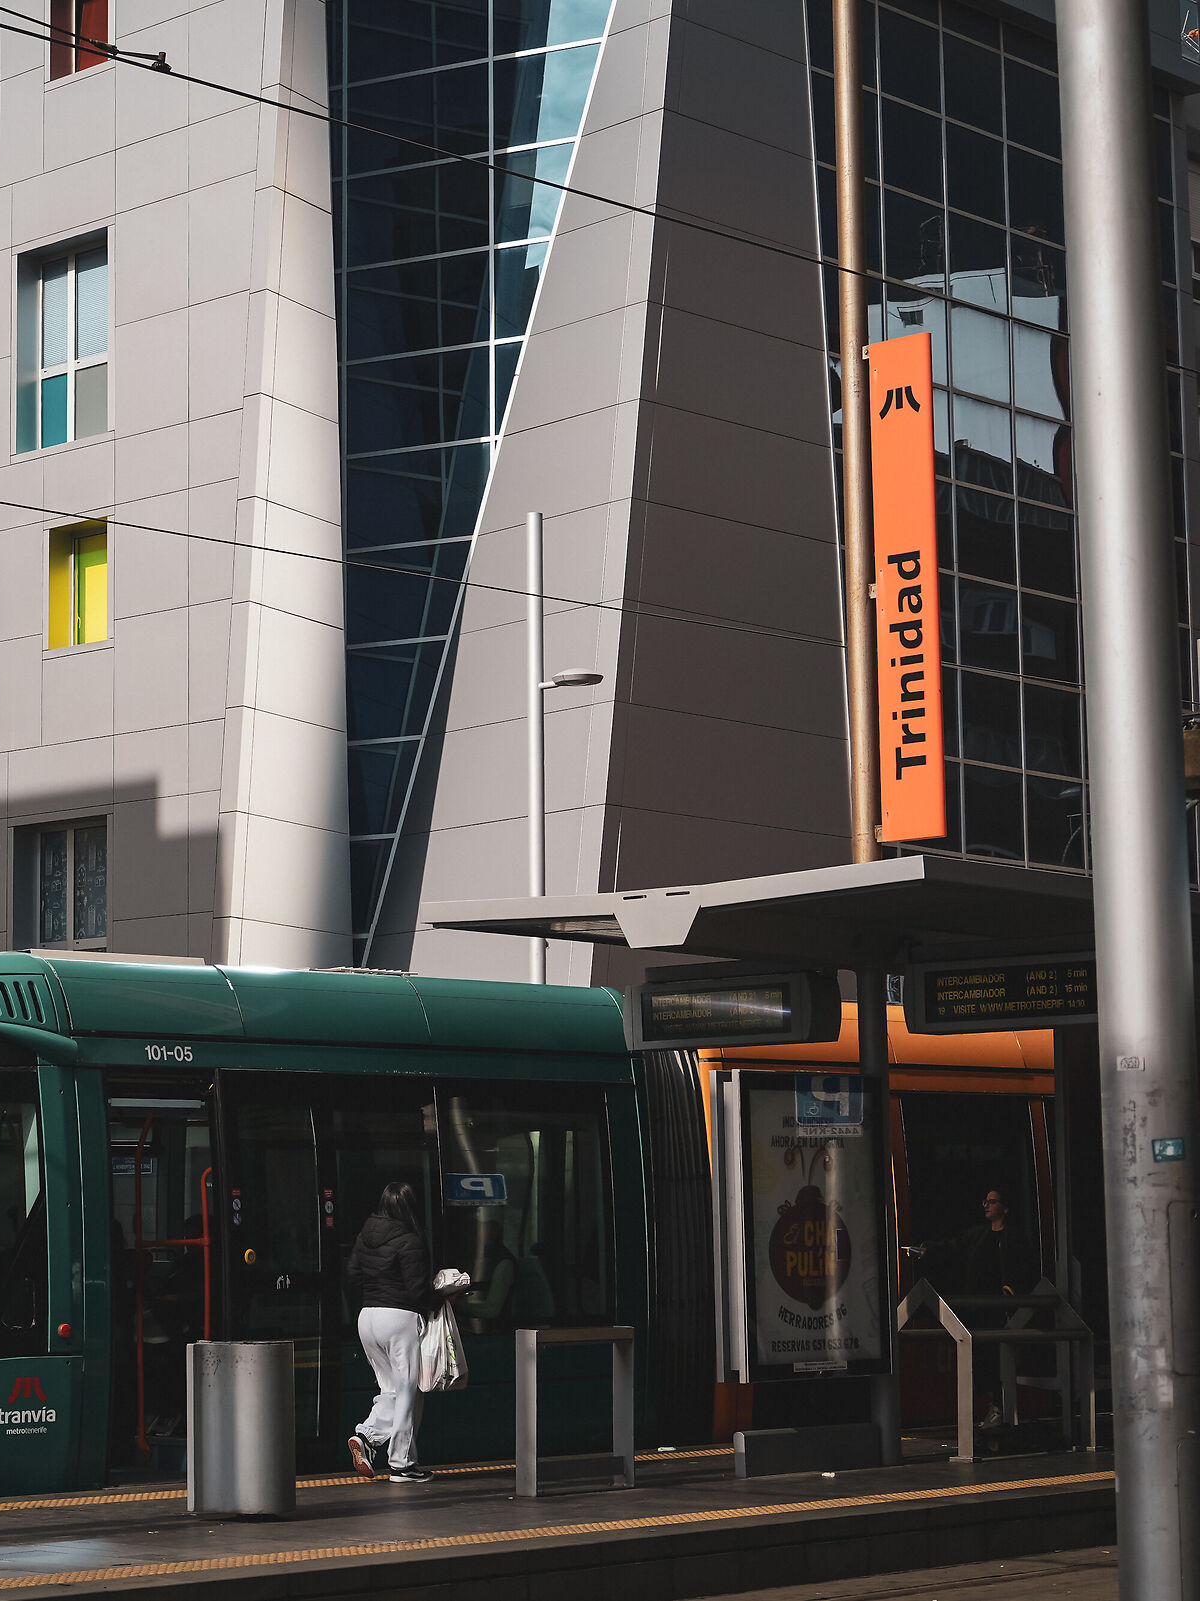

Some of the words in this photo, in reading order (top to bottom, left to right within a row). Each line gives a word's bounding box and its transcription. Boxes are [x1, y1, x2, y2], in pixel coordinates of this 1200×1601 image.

[887, 549, 927, 780] Trinidad
[936, 973, 1005, 986] INTERCAMBIADOR
[1073, 968, 1087, 977] min
[936, 987, 1006, 1001] INTERCAMBIADOR
[1026, 984, 1048, 998] (AND
[1073, 982, 1088, 992] min
[953, 1003, 977, 1015] VISITE
[144, 1045, 193, 1062] 101-05
[770, 1136, 794, 1148] AHORA
[803, 1219, 837, 1247] CHA
[785, 1247, 836, 1278] PULÍN
[778, 1304, 835, 1331] HERRADORES
[771, 1339, 811, 1353] RESERVAS
[6, 1426, 48, 1436] metrotenerife
